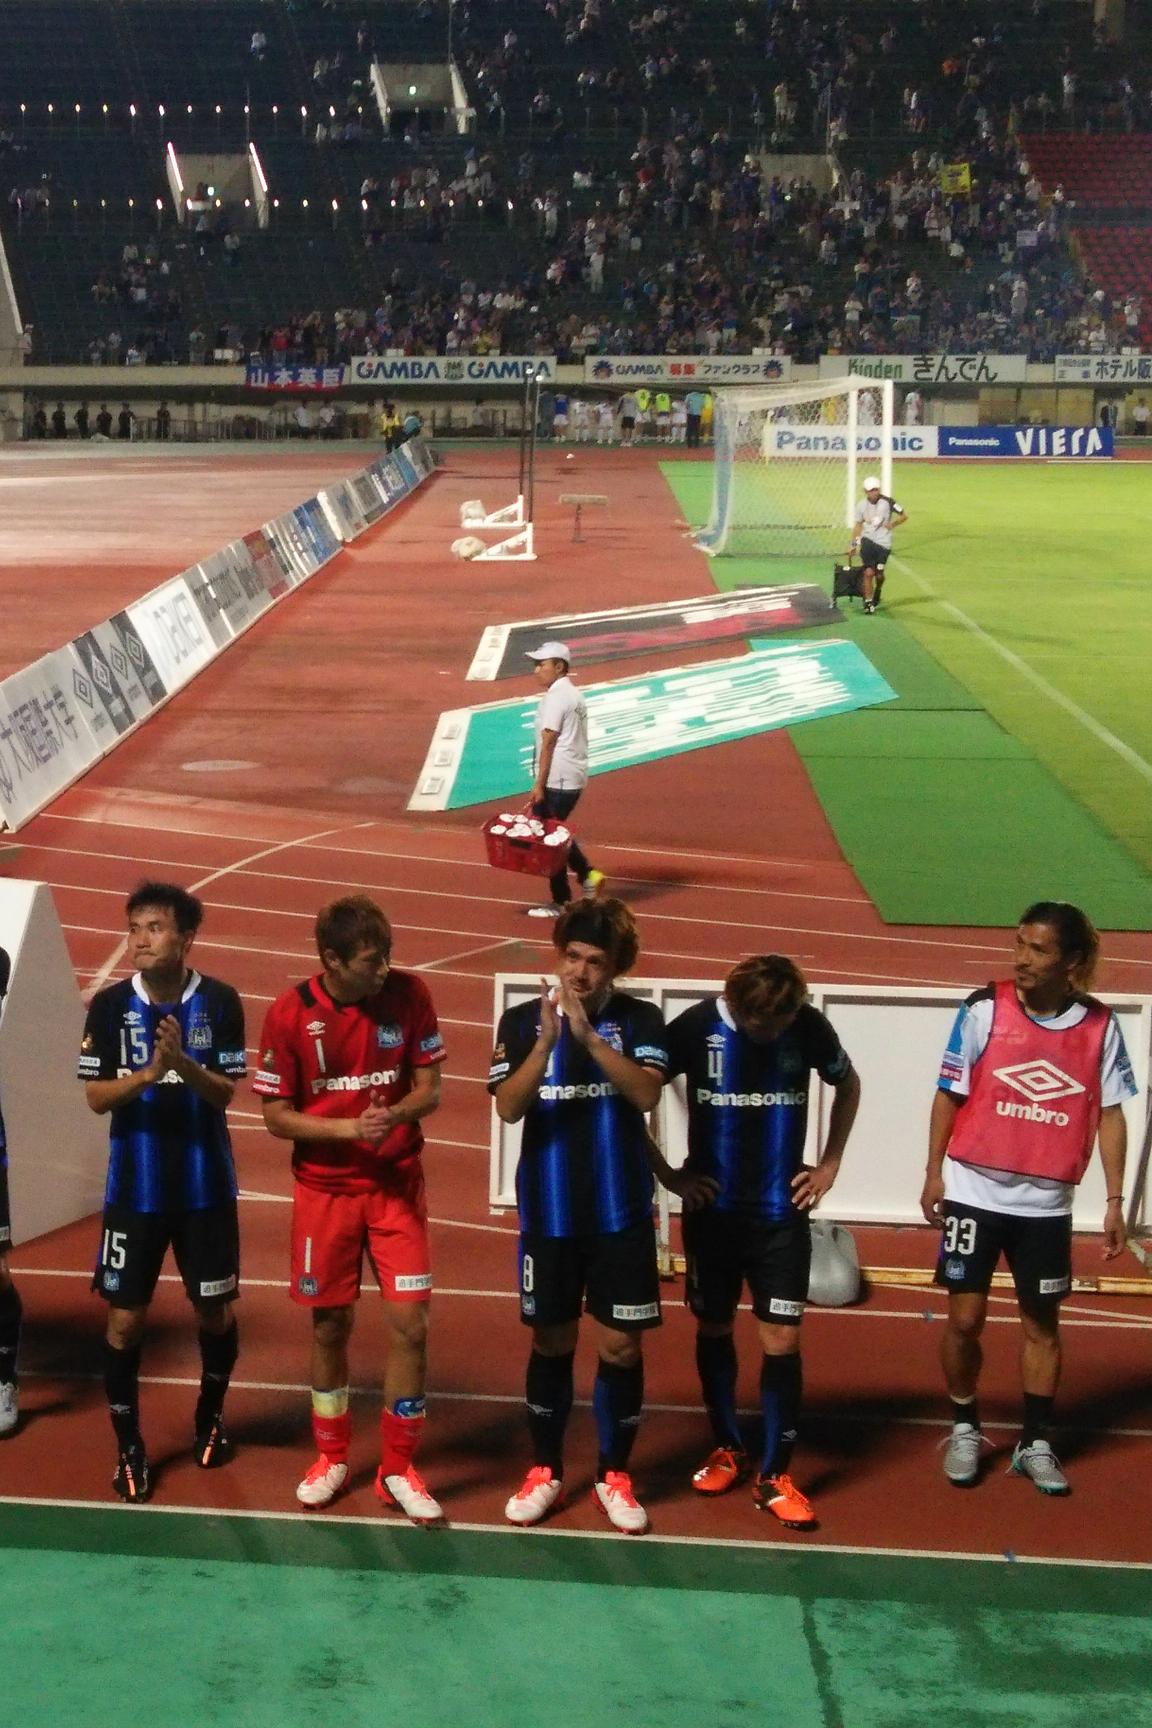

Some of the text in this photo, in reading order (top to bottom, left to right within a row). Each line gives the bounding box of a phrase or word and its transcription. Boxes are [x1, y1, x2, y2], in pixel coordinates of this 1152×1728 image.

[356, 361, 439, 379] GAMBA
[467, 361, 549, 379] GAMBA
[913, 354, 998, 381] きんでん
[949, 436, 1000, 446] Panasonic
[119, 1027, 148, 1066] 15
[707, 1050, 724, 1086] 4
[697, 1088, 806, 1107] Panasonic
[996, 1100, 1070, 1127] umbro
[944, 1216, 977, 1255] 33
[102, 1229, 127, 1270] 15
[523, 1254, 534, 1292] 8
